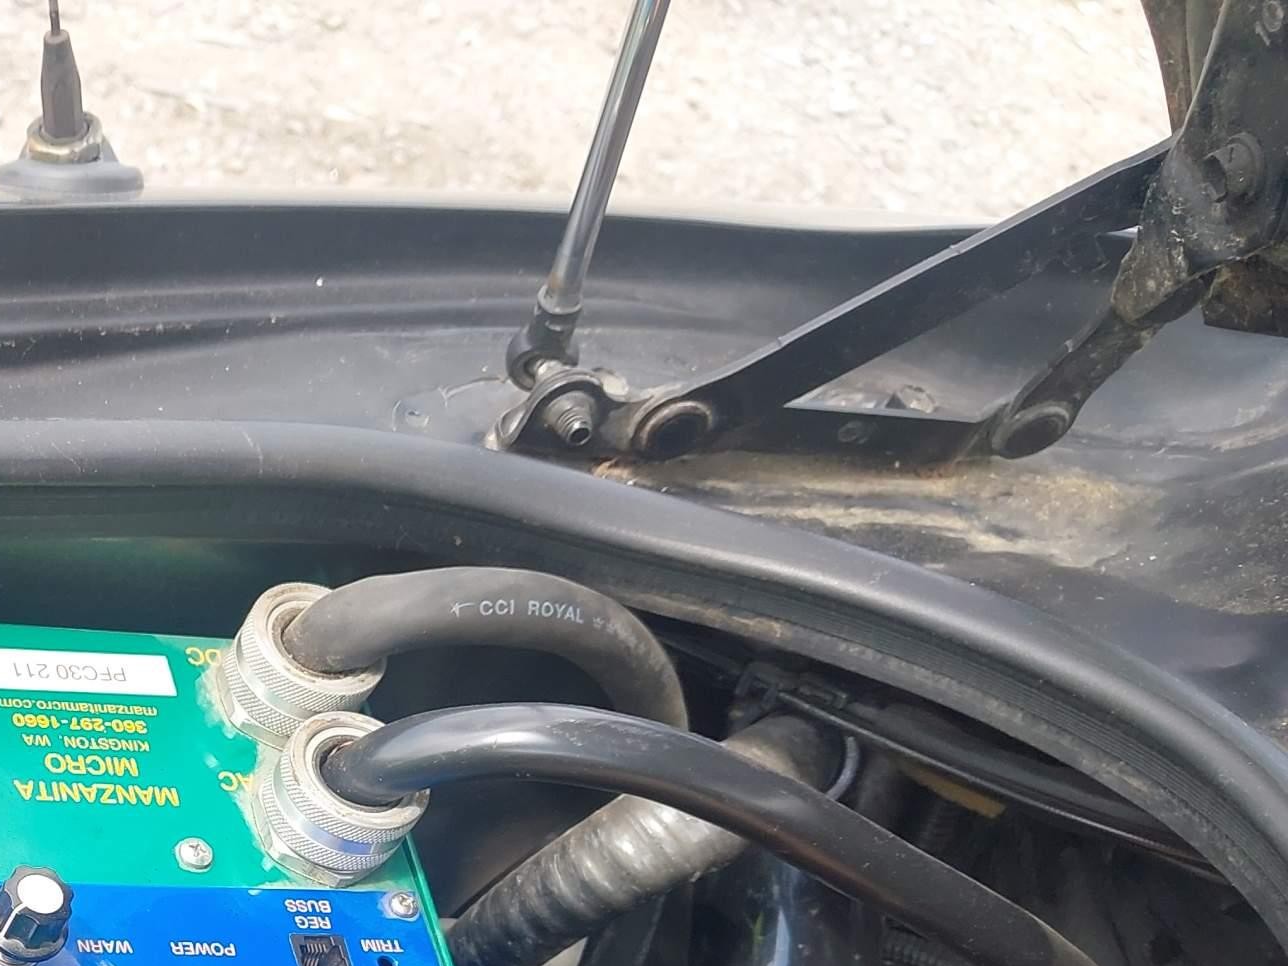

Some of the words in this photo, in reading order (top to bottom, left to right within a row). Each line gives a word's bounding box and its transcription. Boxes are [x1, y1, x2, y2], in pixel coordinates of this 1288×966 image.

[479, 599, 515, 616] CCI
[528, 600, 584, 624] ROYAL
[185, 647, 222, 666] DC
[13, 662, 50, 679] 211
[56, 663, 128, 682] PFC30
[11, 713, 148, 734] 360-297-1660
[21, 733, 52, 747] WA
[44, 752, 139, 777] MICRO
[13, 779, 180, 807] MANZANITA
[284, 899, 332, 914] BUSS
[293, 915, 332, 929] REG
[77, 938, 134, 954] WARN
[169, 940, 237, 957] POWER
[360, 938, 404, 953] TRIM
